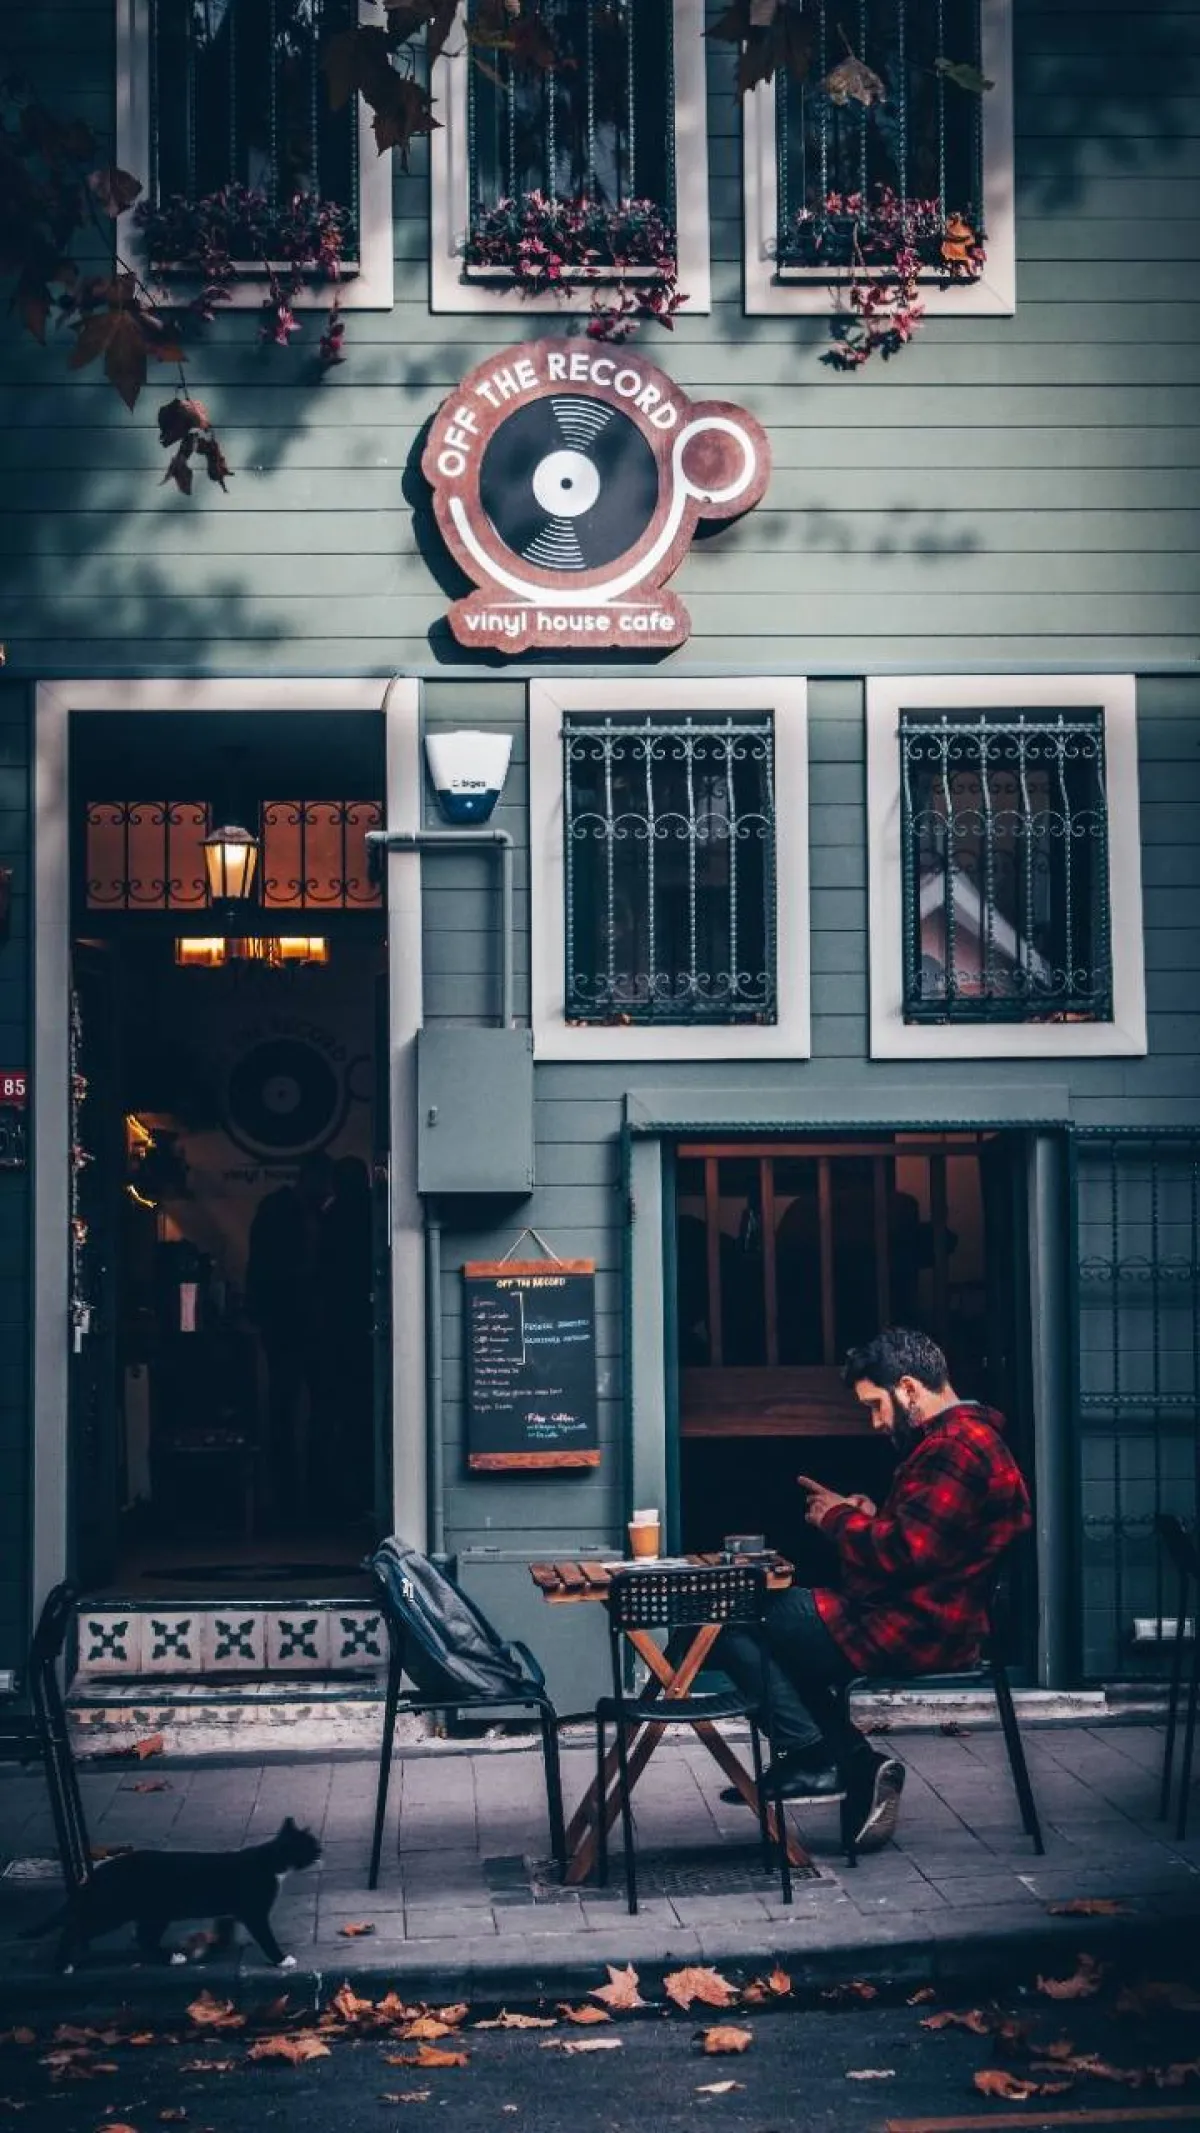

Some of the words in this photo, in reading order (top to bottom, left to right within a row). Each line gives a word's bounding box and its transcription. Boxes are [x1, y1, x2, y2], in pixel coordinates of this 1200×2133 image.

[437, 406, 482, 478] OFF
[473, 359, 539, 408] THE
[547, 352, 678, 430] RECORD
[464, 611, 527, 637] vinyl
[536, 611, 611, 632] house
[619, 611, 676, 632] cafe
[4, 1079, 26, 1096] 85
